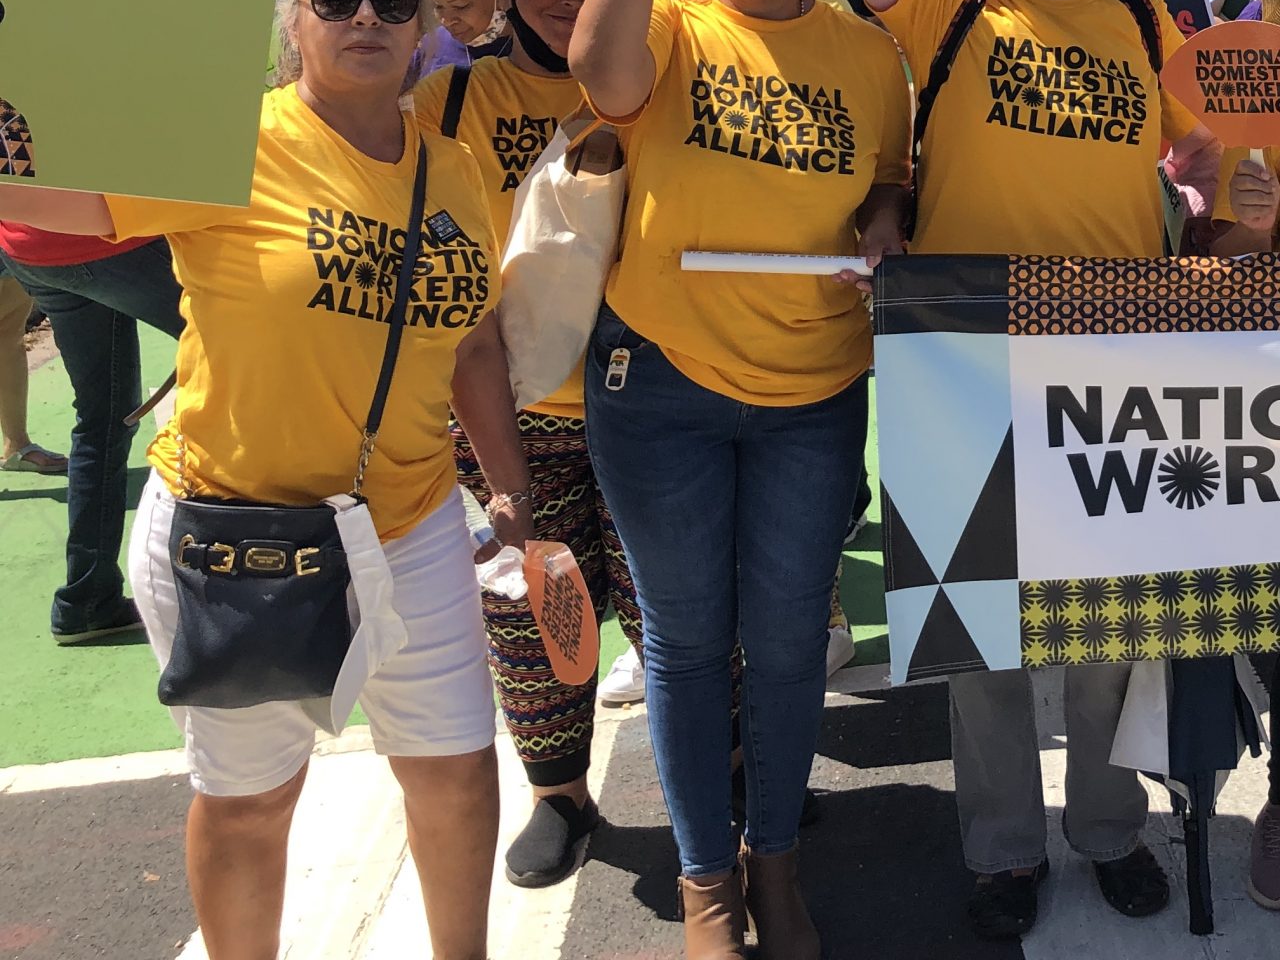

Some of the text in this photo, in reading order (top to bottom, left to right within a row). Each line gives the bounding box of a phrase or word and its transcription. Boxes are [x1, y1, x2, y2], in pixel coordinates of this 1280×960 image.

[987, 54, 1147, 100] DOMESTIC
[993, 35, 1140, 81] NATIONAL
[690, 79, 855, 132] DOMESTIC
[697, 58, 849, 113] NATIONAL
[989, 77, 1147, 122] WORKERS
[496, 113, 558, 136] NATI
[692, 98, 856, 151] WORKERS
[985, 101, 1144, 146] ALLIANCE
[684, 123, 855, 175] ALLIANCE
